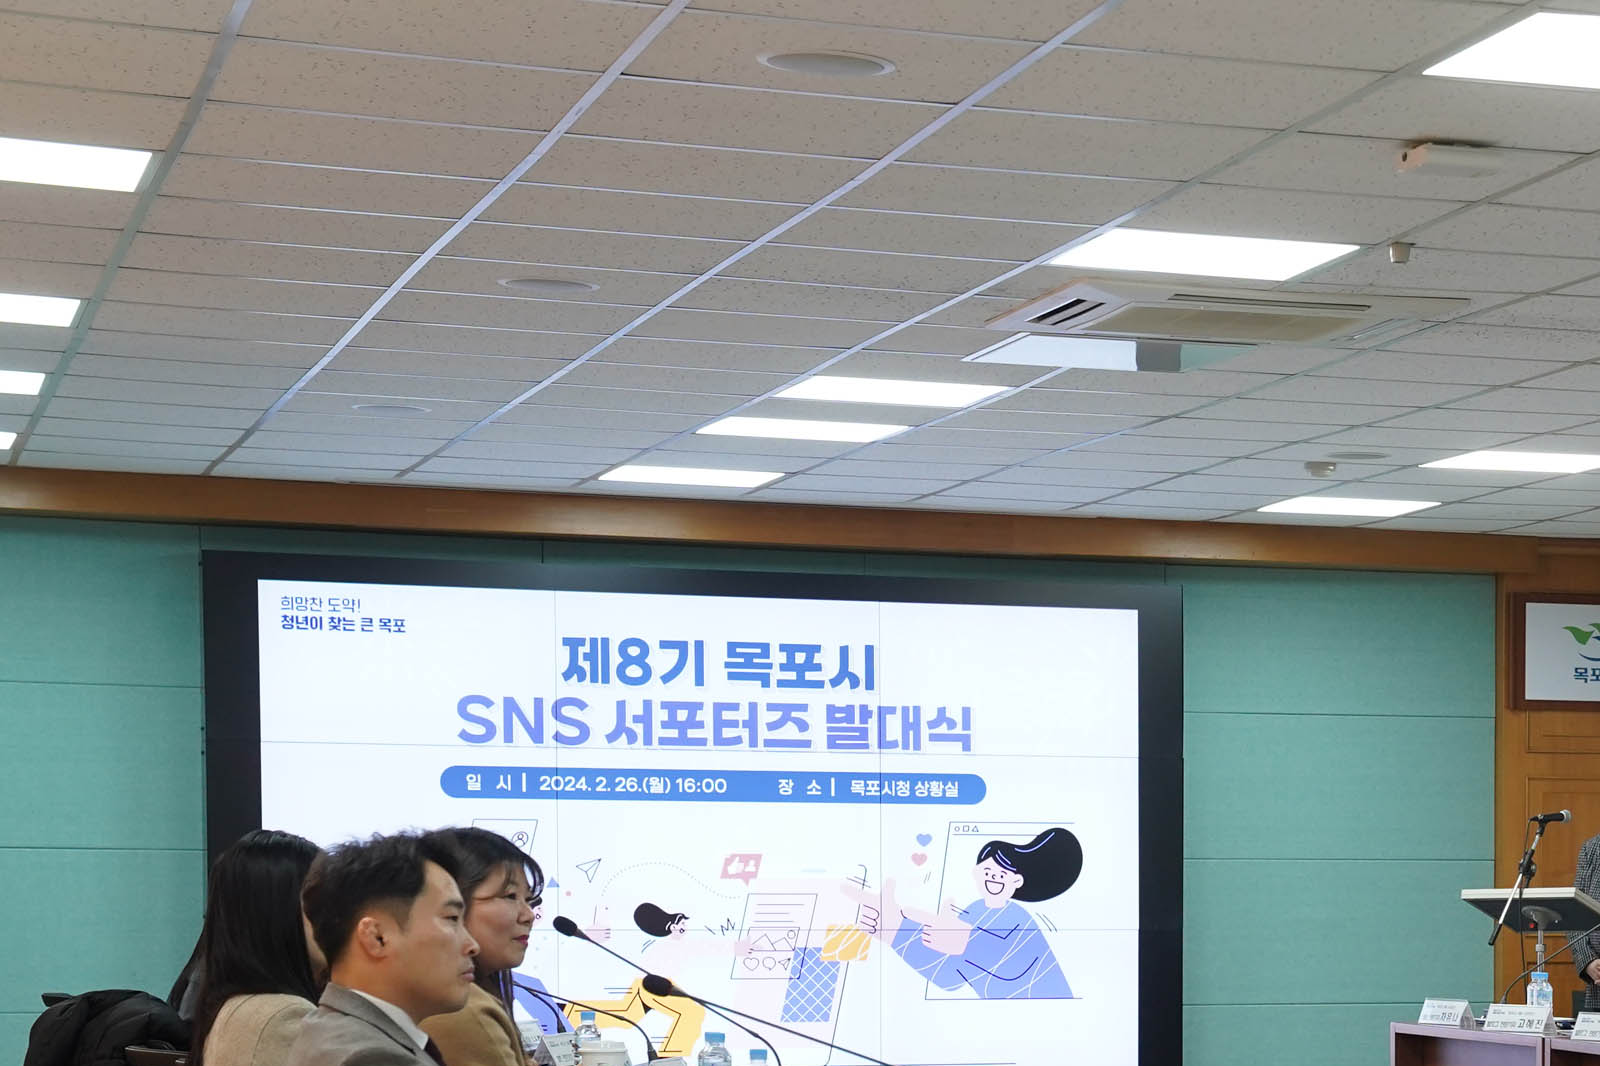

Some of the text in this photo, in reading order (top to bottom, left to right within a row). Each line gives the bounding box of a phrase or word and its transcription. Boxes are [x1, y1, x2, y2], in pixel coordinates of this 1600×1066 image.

[281, 595, 361, 613] 희망찬 도약!
[281, 614, 407, 633] 청년이 찾는 큰 목포
[561, 636, 875, 691] 제8기 목포시
[456, 694, 973, 752] SNS 서포터즈 발대식
[539, 775, 592, 792] 2024.
[595, 776, 611, 792] 2.
[675, 777, 728, 794] 16:00
[850, 779, 911, 797] 목포시청
[914, 780, 959, 798] 상황실
